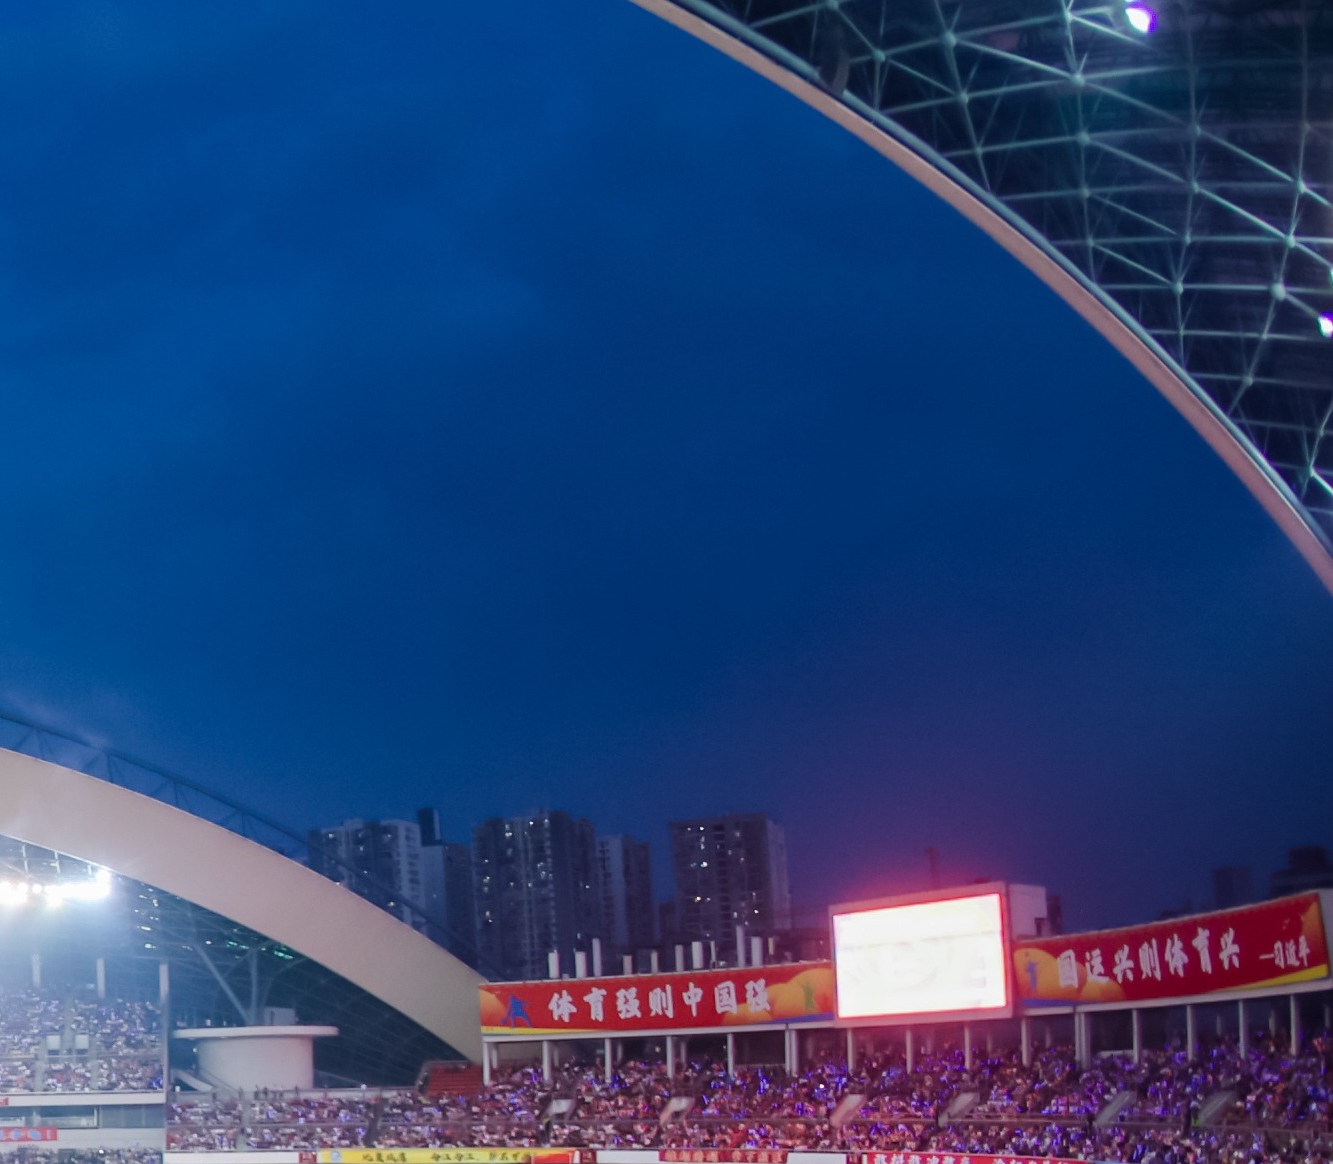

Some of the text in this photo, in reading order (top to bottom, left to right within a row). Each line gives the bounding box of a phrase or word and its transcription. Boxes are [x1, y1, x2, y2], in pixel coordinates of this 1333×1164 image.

[1056, 926, 1241, 989] 国运兴则体育兴
[547, 978, 772, 1023] 体育强则中国强
